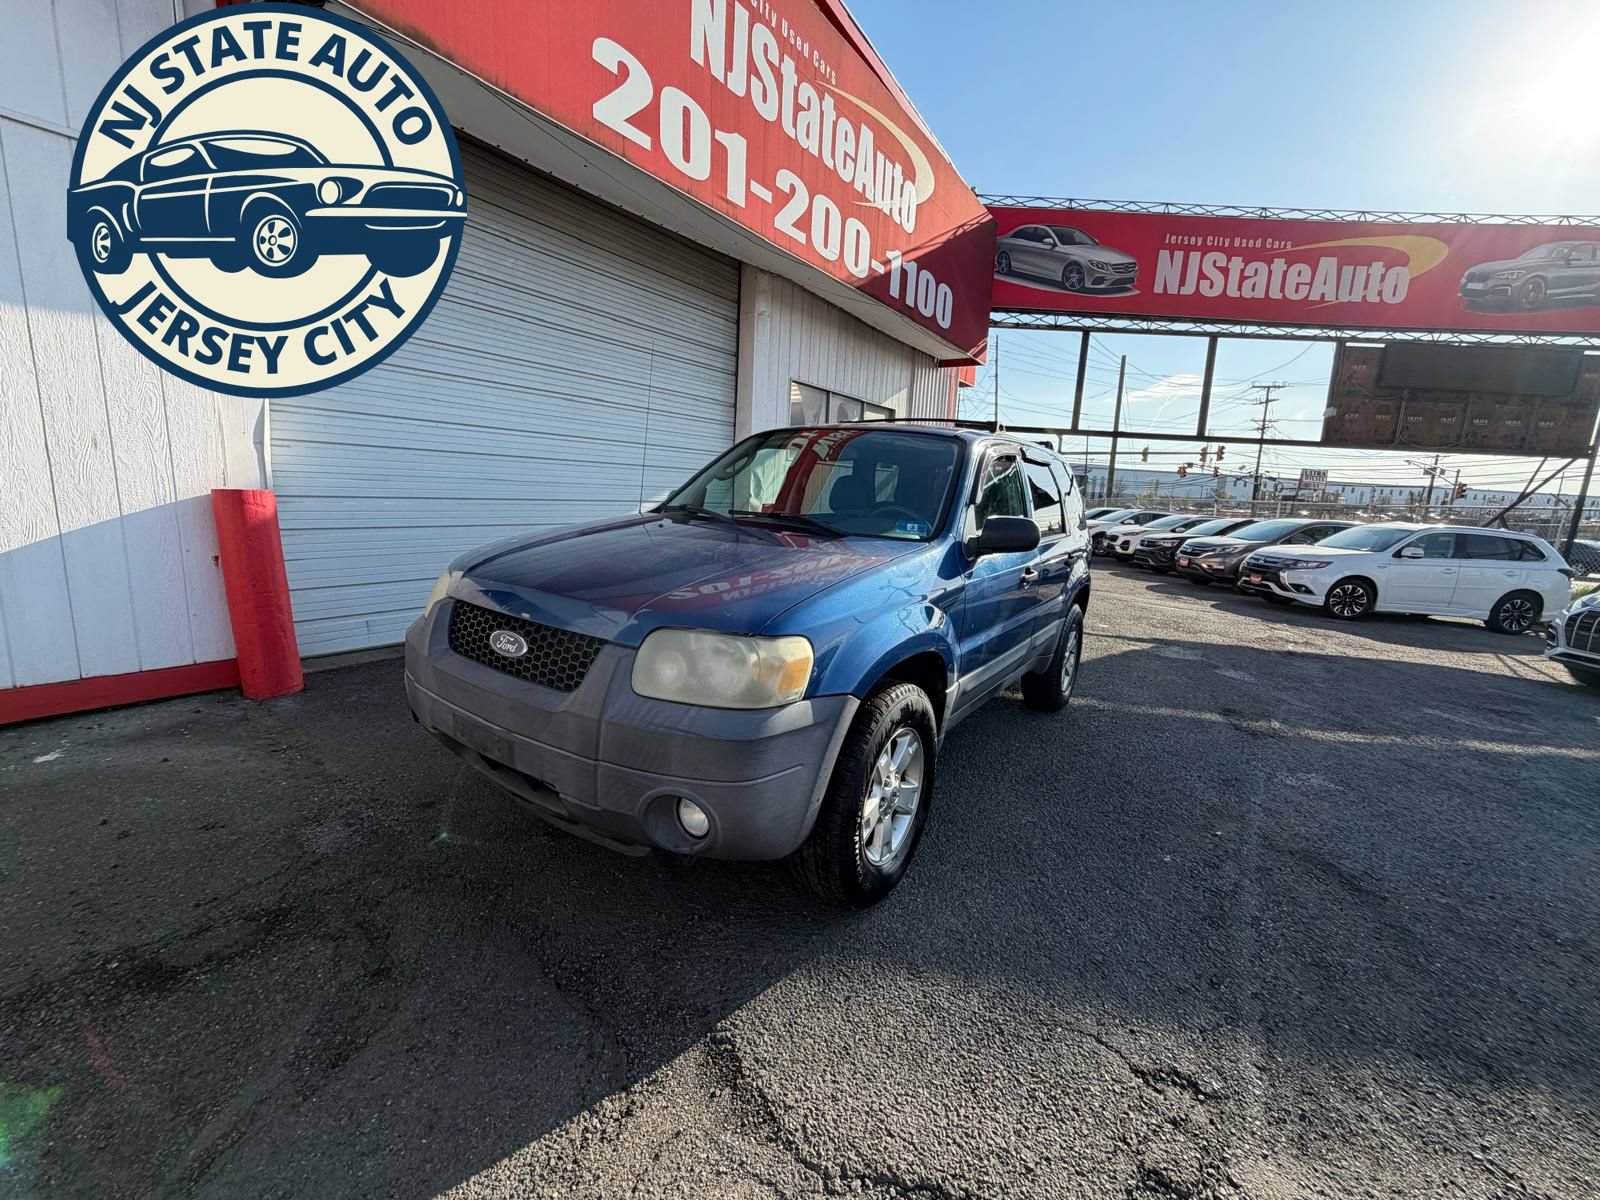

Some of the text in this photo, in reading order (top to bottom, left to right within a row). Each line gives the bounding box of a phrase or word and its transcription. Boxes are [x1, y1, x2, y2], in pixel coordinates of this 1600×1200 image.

[781, 17, 809, 59] Used
[813, 49, 837, 86] Cars
[690, 0, 917, 234] NJStateAuto
[592, 37, 953, 330] 201-200-1100
[1165, 233, 1293, 250] Jersey City Used Cars
[1154, 249, 1411, 304] NJStateAuto
[496, 633, 519, 652] Ford
